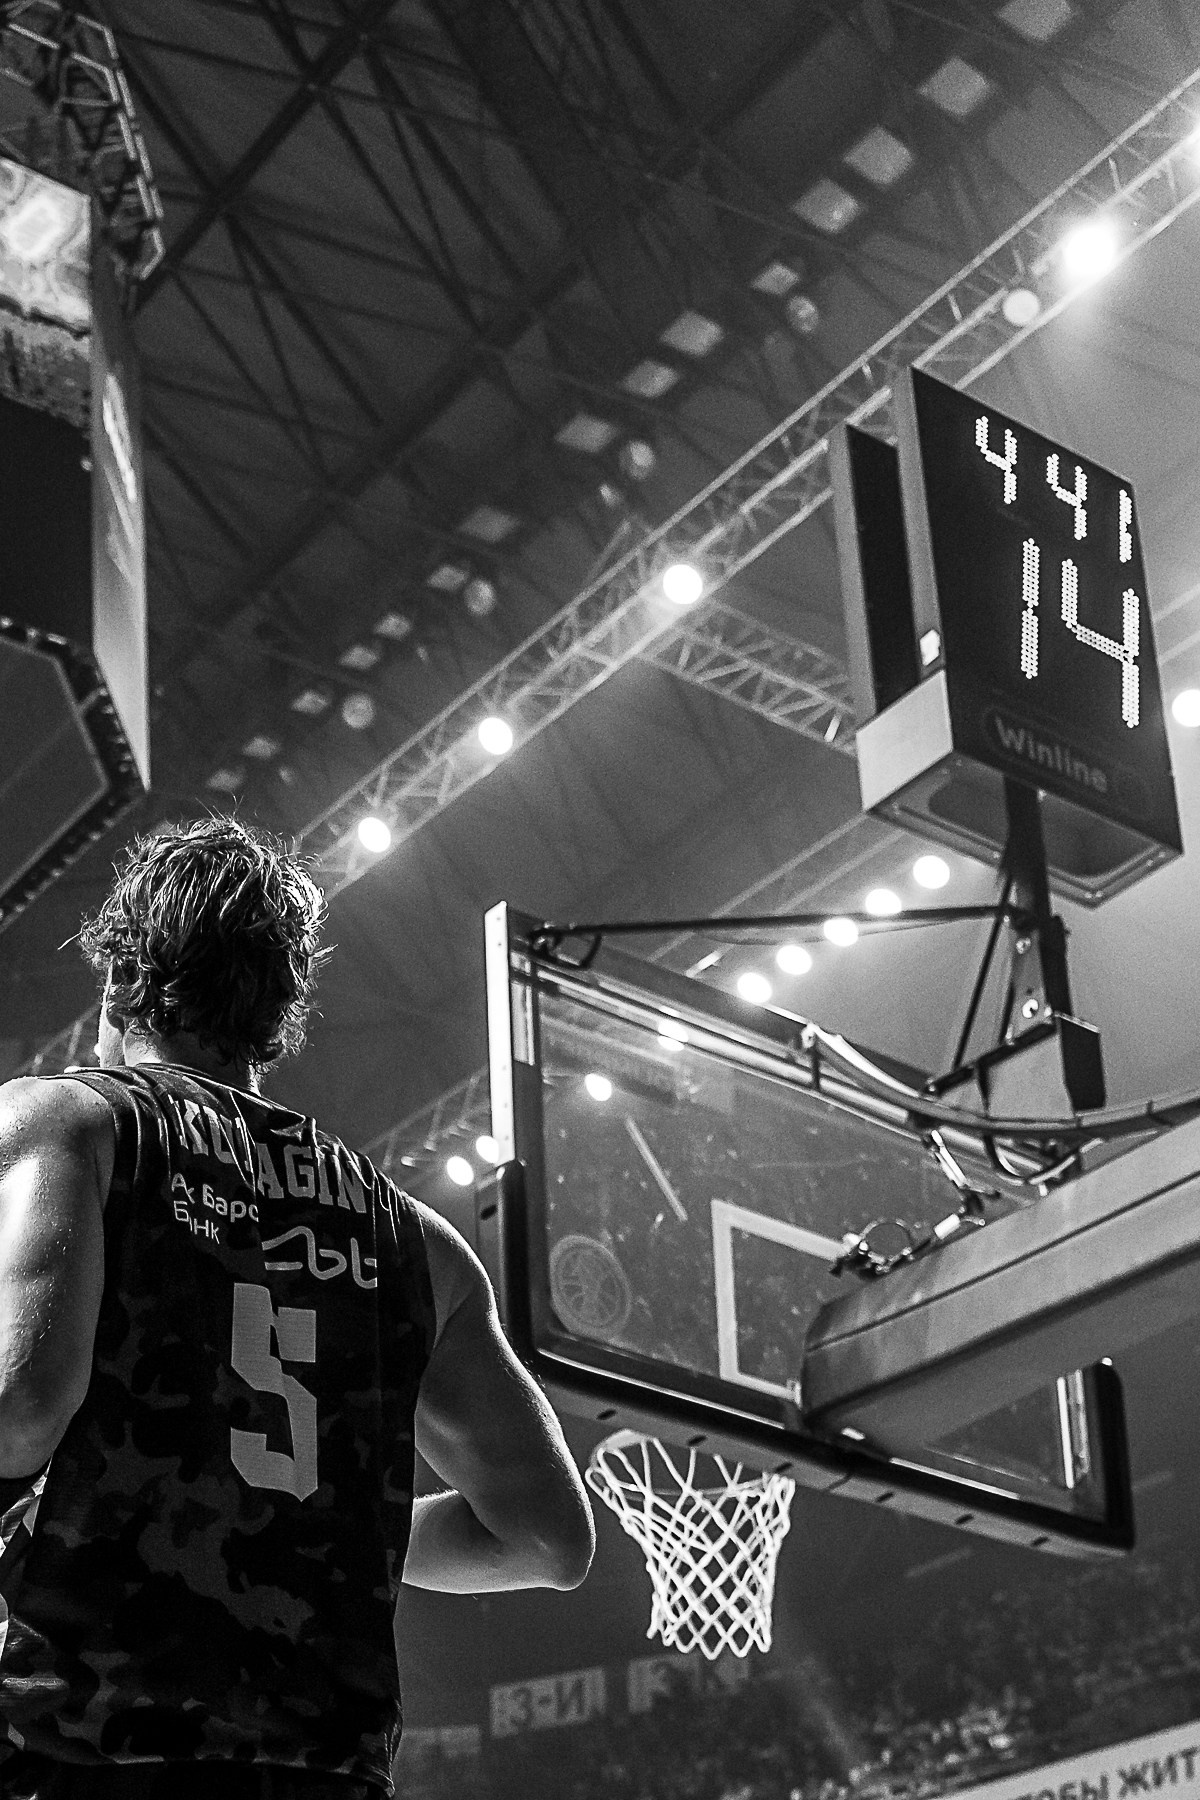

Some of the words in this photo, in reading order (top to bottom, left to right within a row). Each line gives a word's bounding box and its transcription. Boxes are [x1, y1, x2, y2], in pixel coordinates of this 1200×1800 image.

[1020, 537, 1140, 729] 14
[173, 1201, 220, 1245] Бнк
[230, 1282, 319, 1503] 5
